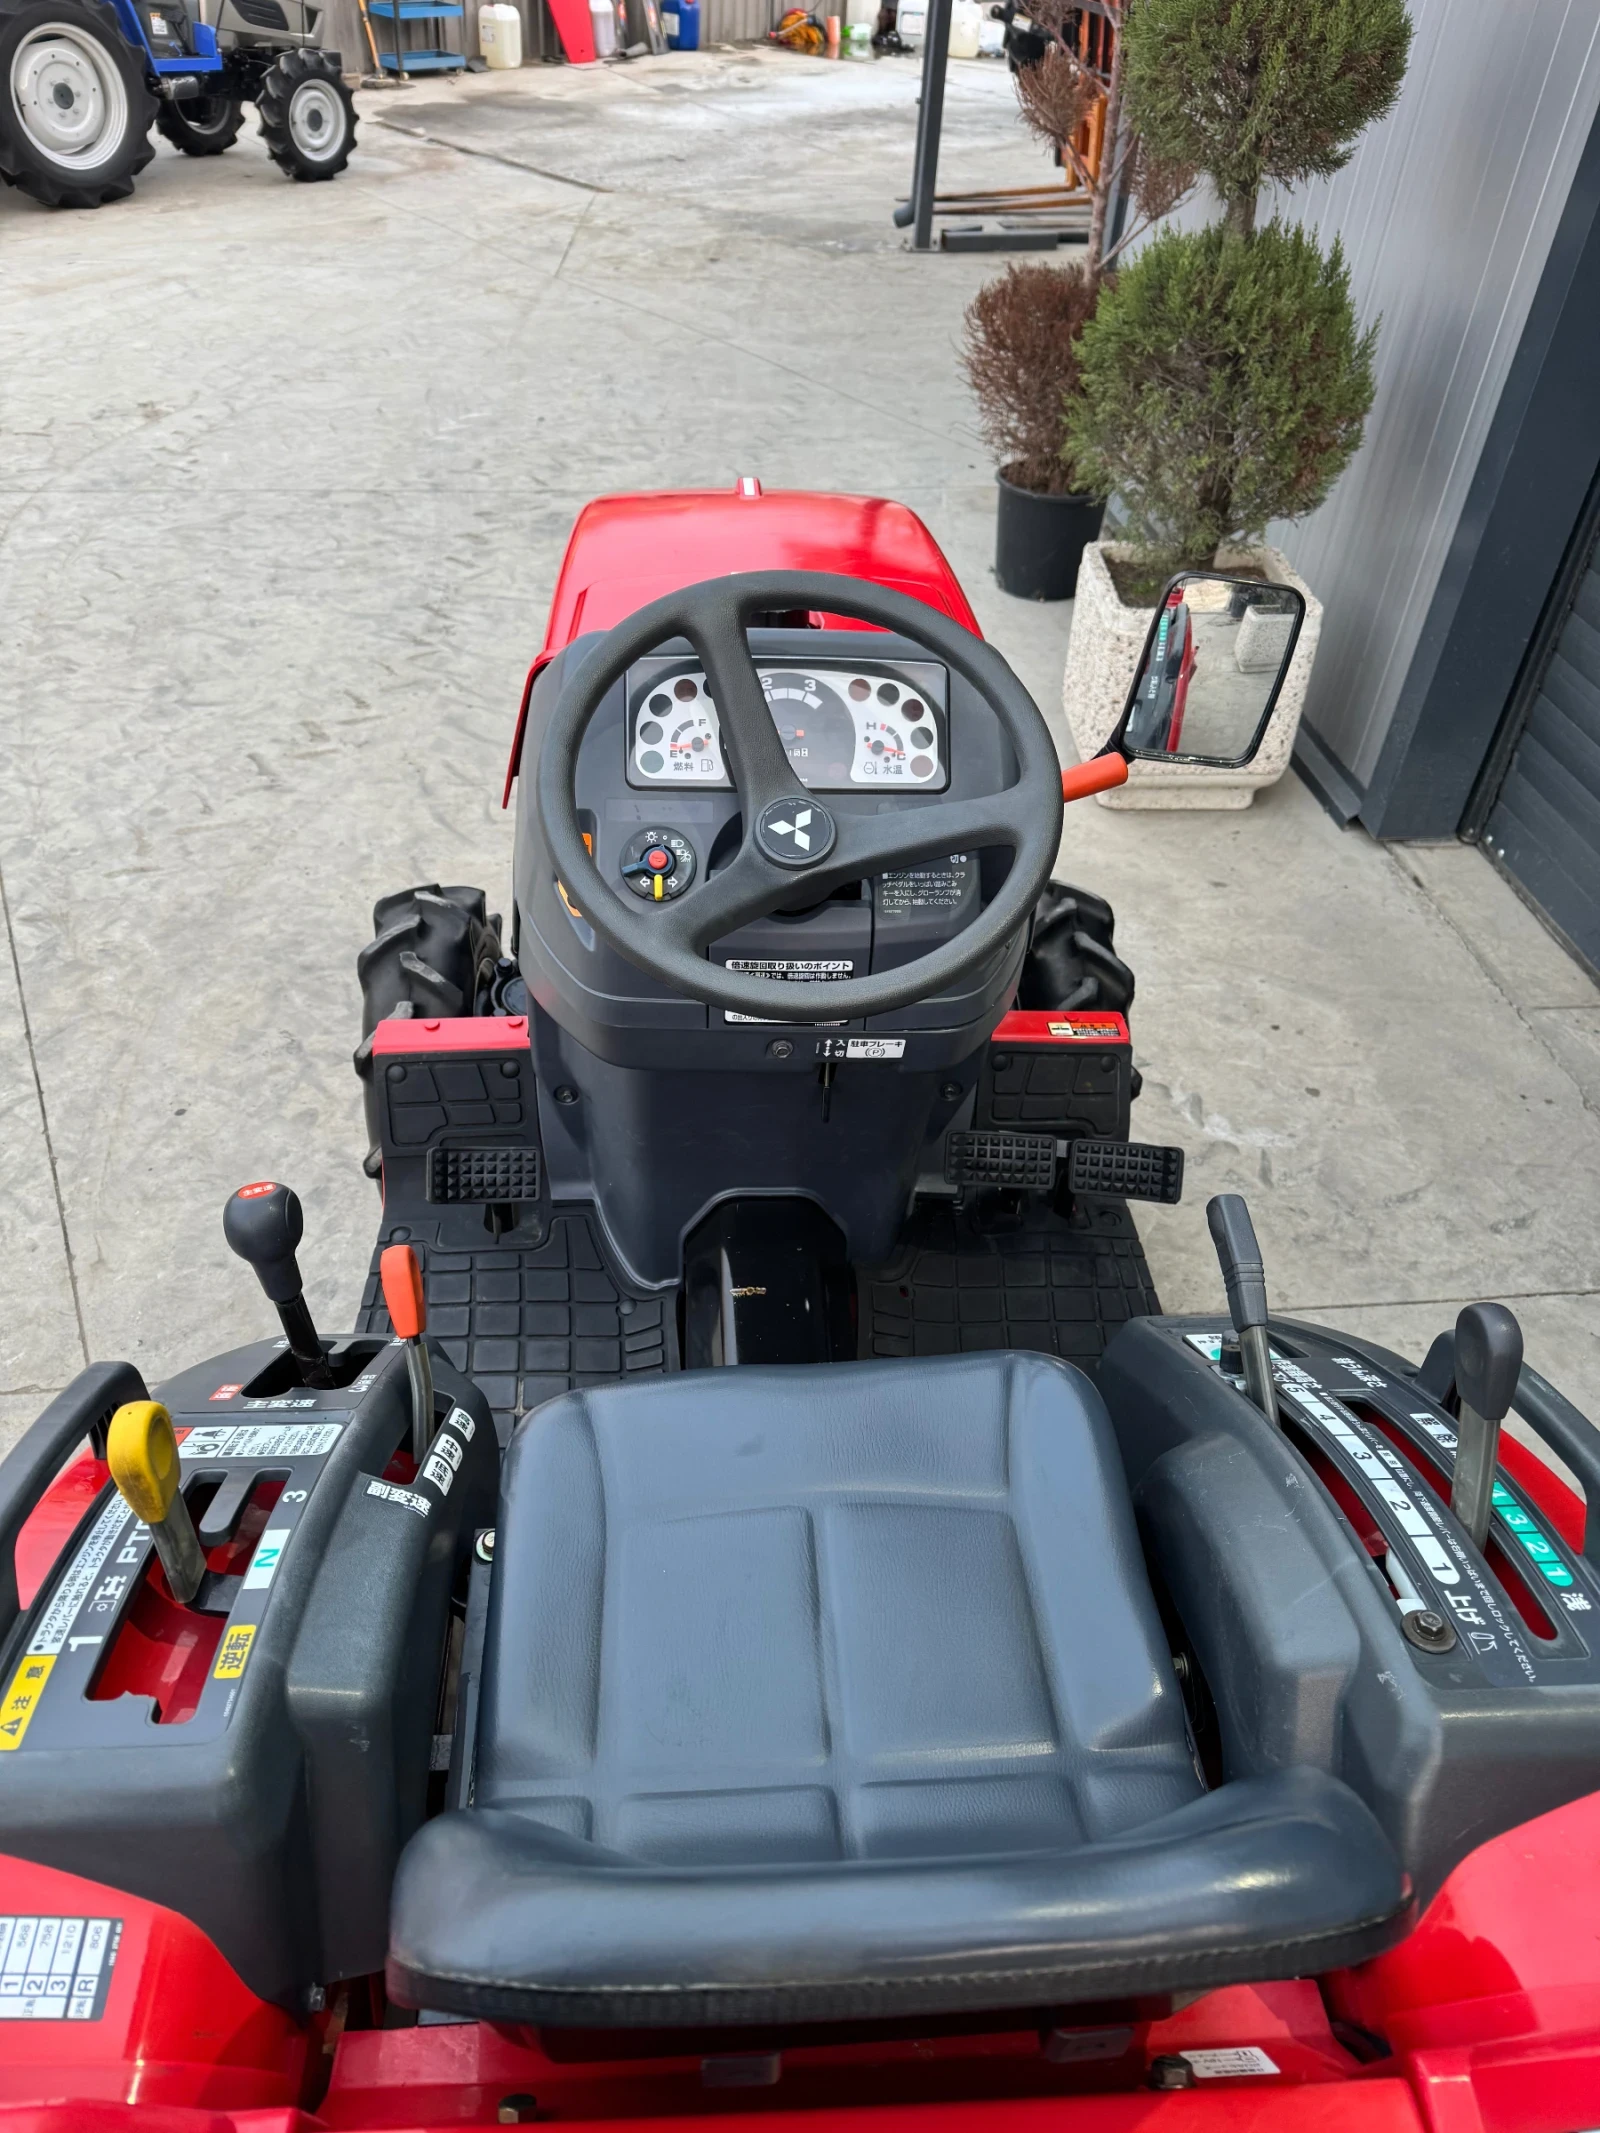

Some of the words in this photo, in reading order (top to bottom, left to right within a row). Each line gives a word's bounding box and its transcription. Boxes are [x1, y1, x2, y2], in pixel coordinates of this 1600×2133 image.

[762, 678, 773, 690] 2
[804, 679, 816, 692] 3
[698, 718, 707, 727] F
[866, 722, 877, 730] H
[670, 750, 679, 758] E
[673, 761, 694, 772] 燃料
[882, 764, 904, 775] 水温
[950, 854, 959, 864] 切
[731, 961, 850, 970] 倍速旋回取り扱いのポイント
[836, 1039, 846, 1047] 入
[850, 1040, 903, 1048] 駐車ブレーキ
[834, 1050, 845, 1058] 切
[243, 1399, 317, 1409] 主変速
[454, 1412, 472, 1434] 高速
[440, 1438, 458, 1463] 中速
[1352, 1451, 1373, 1461] 3
[430, 1460, 449, 1487] 低速
[282, 1489, 308, 1503] 3
[366, 1480, 432, 1515] 副変速
[1390, 1500, 1412, 1512] 2
[1506, 1513, 1528, 1525] 3
[1525, 1541, 1550, 1554] 2
[253, 1548, 281, 1568] N
[1432, 1561, 1453, 1572] 1
[1547, 1566, 1568, 1577] 1
[1560, 1592, 1592, 1611] 浅
[1443, 1590, 1487, 1626] 上げ
[68, 1635, 104, 1652] 1
[219, 1632, 252, 1670] 逆転
[61, 1924, 77, 1954] 1210
[4, 1981, 19, 1990] 1
[27, 1980, 43, 1991] 2
[50, 1980, 67, 1991] 3
[77, 1979, 94, 1992] R
